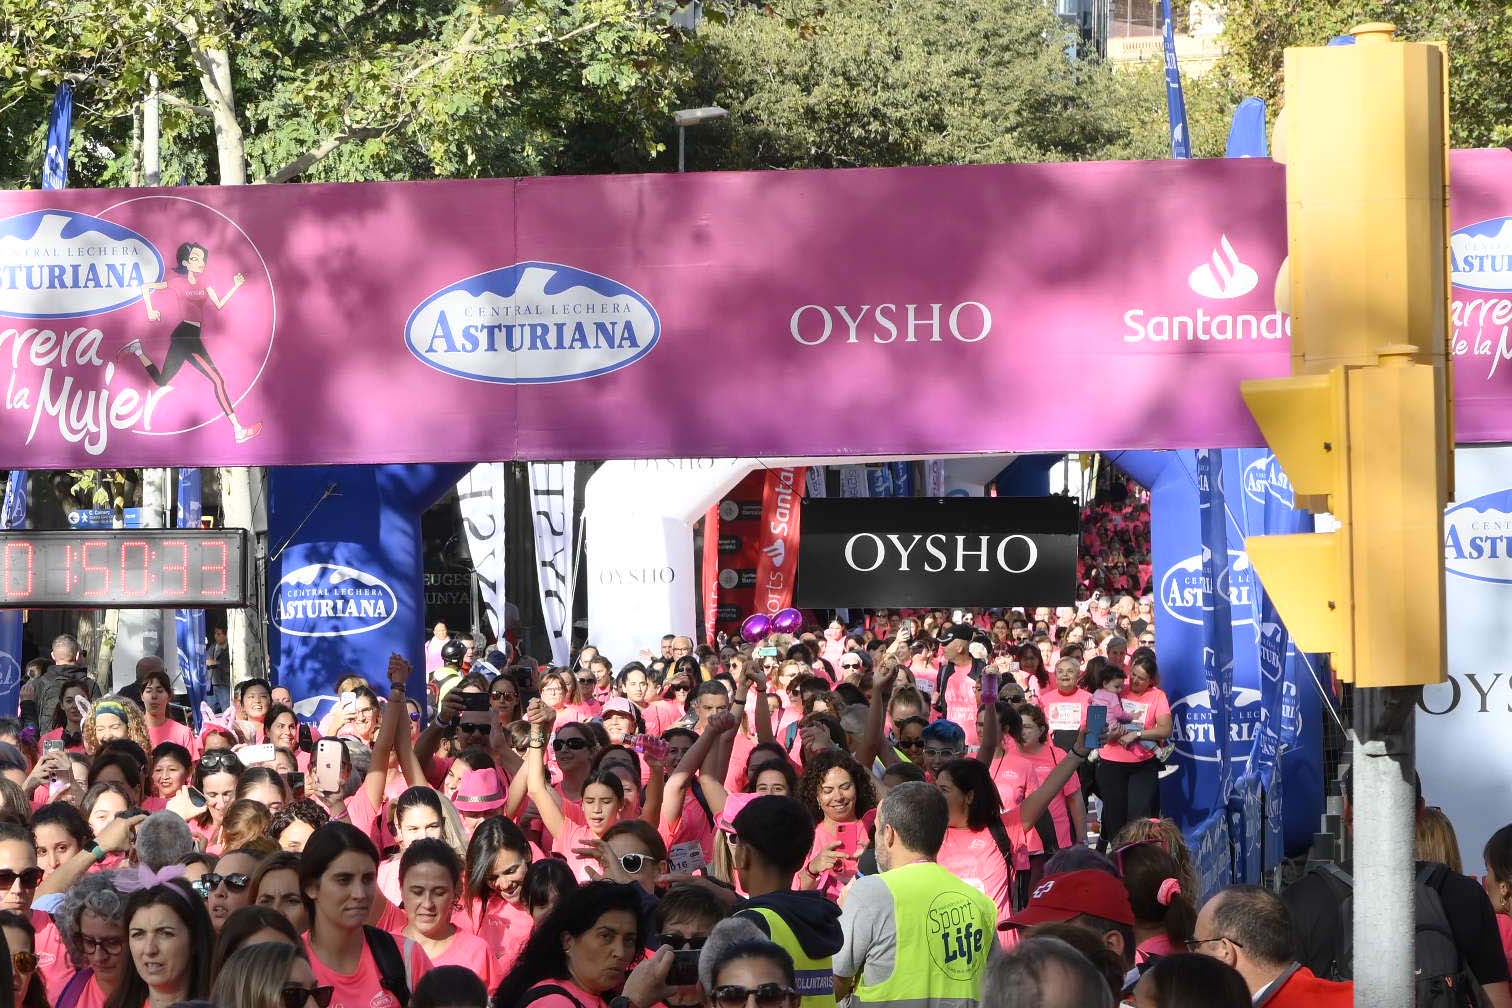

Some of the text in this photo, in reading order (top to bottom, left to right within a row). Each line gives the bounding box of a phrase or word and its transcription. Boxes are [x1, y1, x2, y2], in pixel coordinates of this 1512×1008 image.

[67, 245, 140, 257] LECHERA
[465, 302, 632, 318] CENTRAL LECHERA
[789, 301, 992, 346] OYSHO
[1452, 299, 1512, 328] arre
[424, 309, 641, 354] ASTURIANA
[1473, 332, 1492, 356] la
[6, 372, 30, 410] la
[24, 361, 175, 456] Mujer
[4, 540, 229, 597] 01:50:33
[844, 533, 1037, 574] OYSHO
[600, 566, 676, 585] OYSHO
[275, 594, 387, 621] ASTURIANA
[287, 588, 383, 598] CENTRAL LECHERA
[929, 900, 975, 935] Sport
[942, 923, 983, 965] Life
